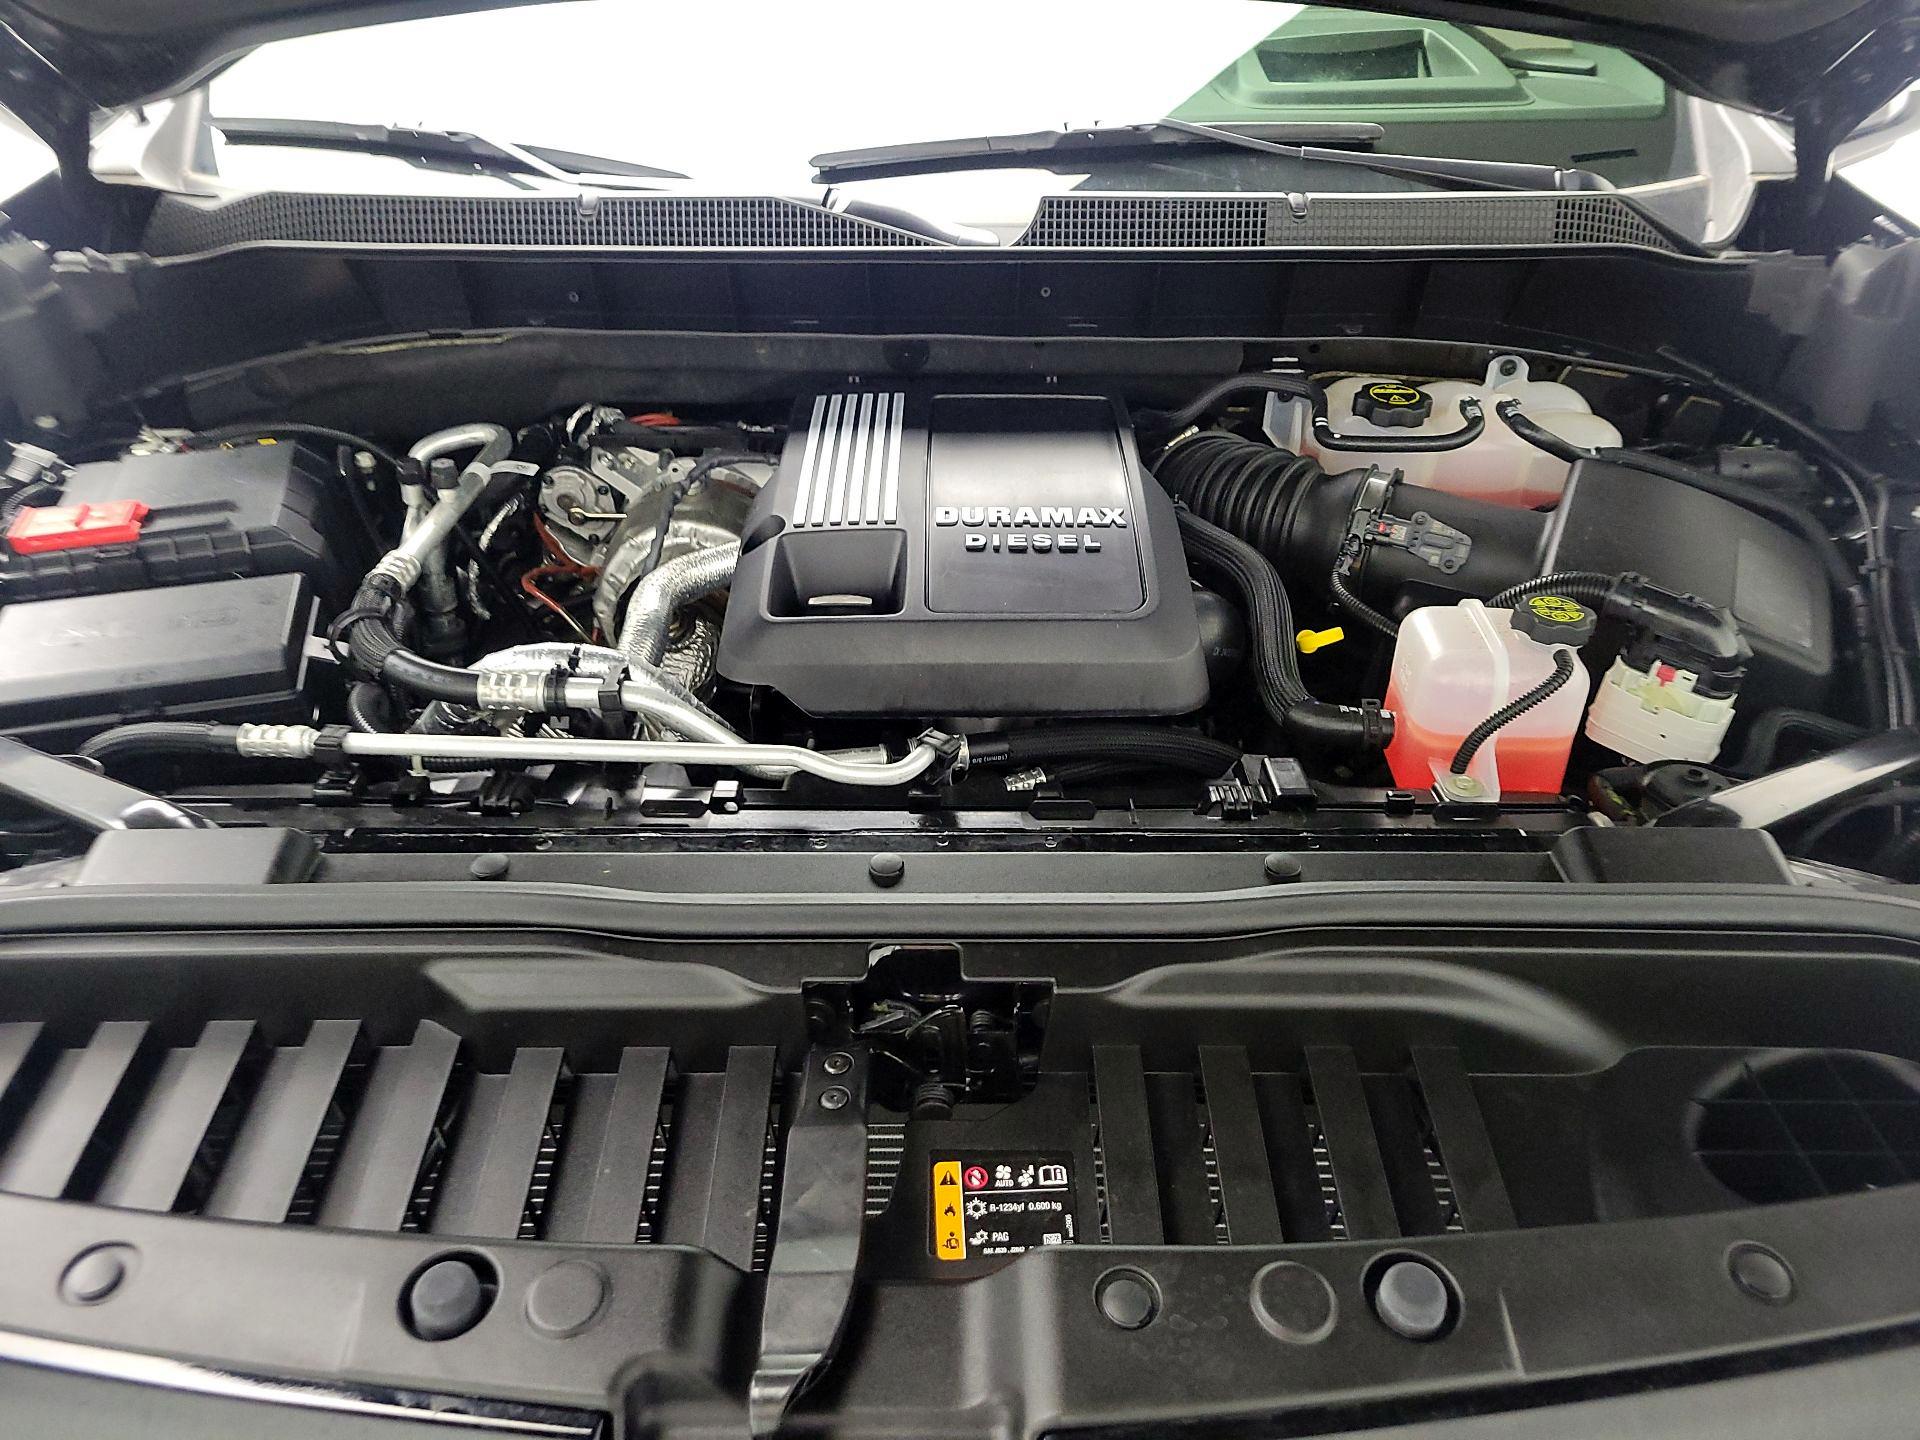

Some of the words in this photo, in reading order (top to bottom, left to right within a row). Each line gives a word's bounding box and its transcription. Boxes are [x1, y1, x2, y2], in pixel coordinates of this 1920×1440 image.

[935, 506, 1127, 527] DURAMAX
[965, 533, 1101, 552] DIESEL
[995, 1179, 1014, 1187] AUTO
[1028, 1201, 1050, 1211] 0.600
[1051, 1200, 1062, 1212] kg
[992, 1232, 1009, 1241] PAG
